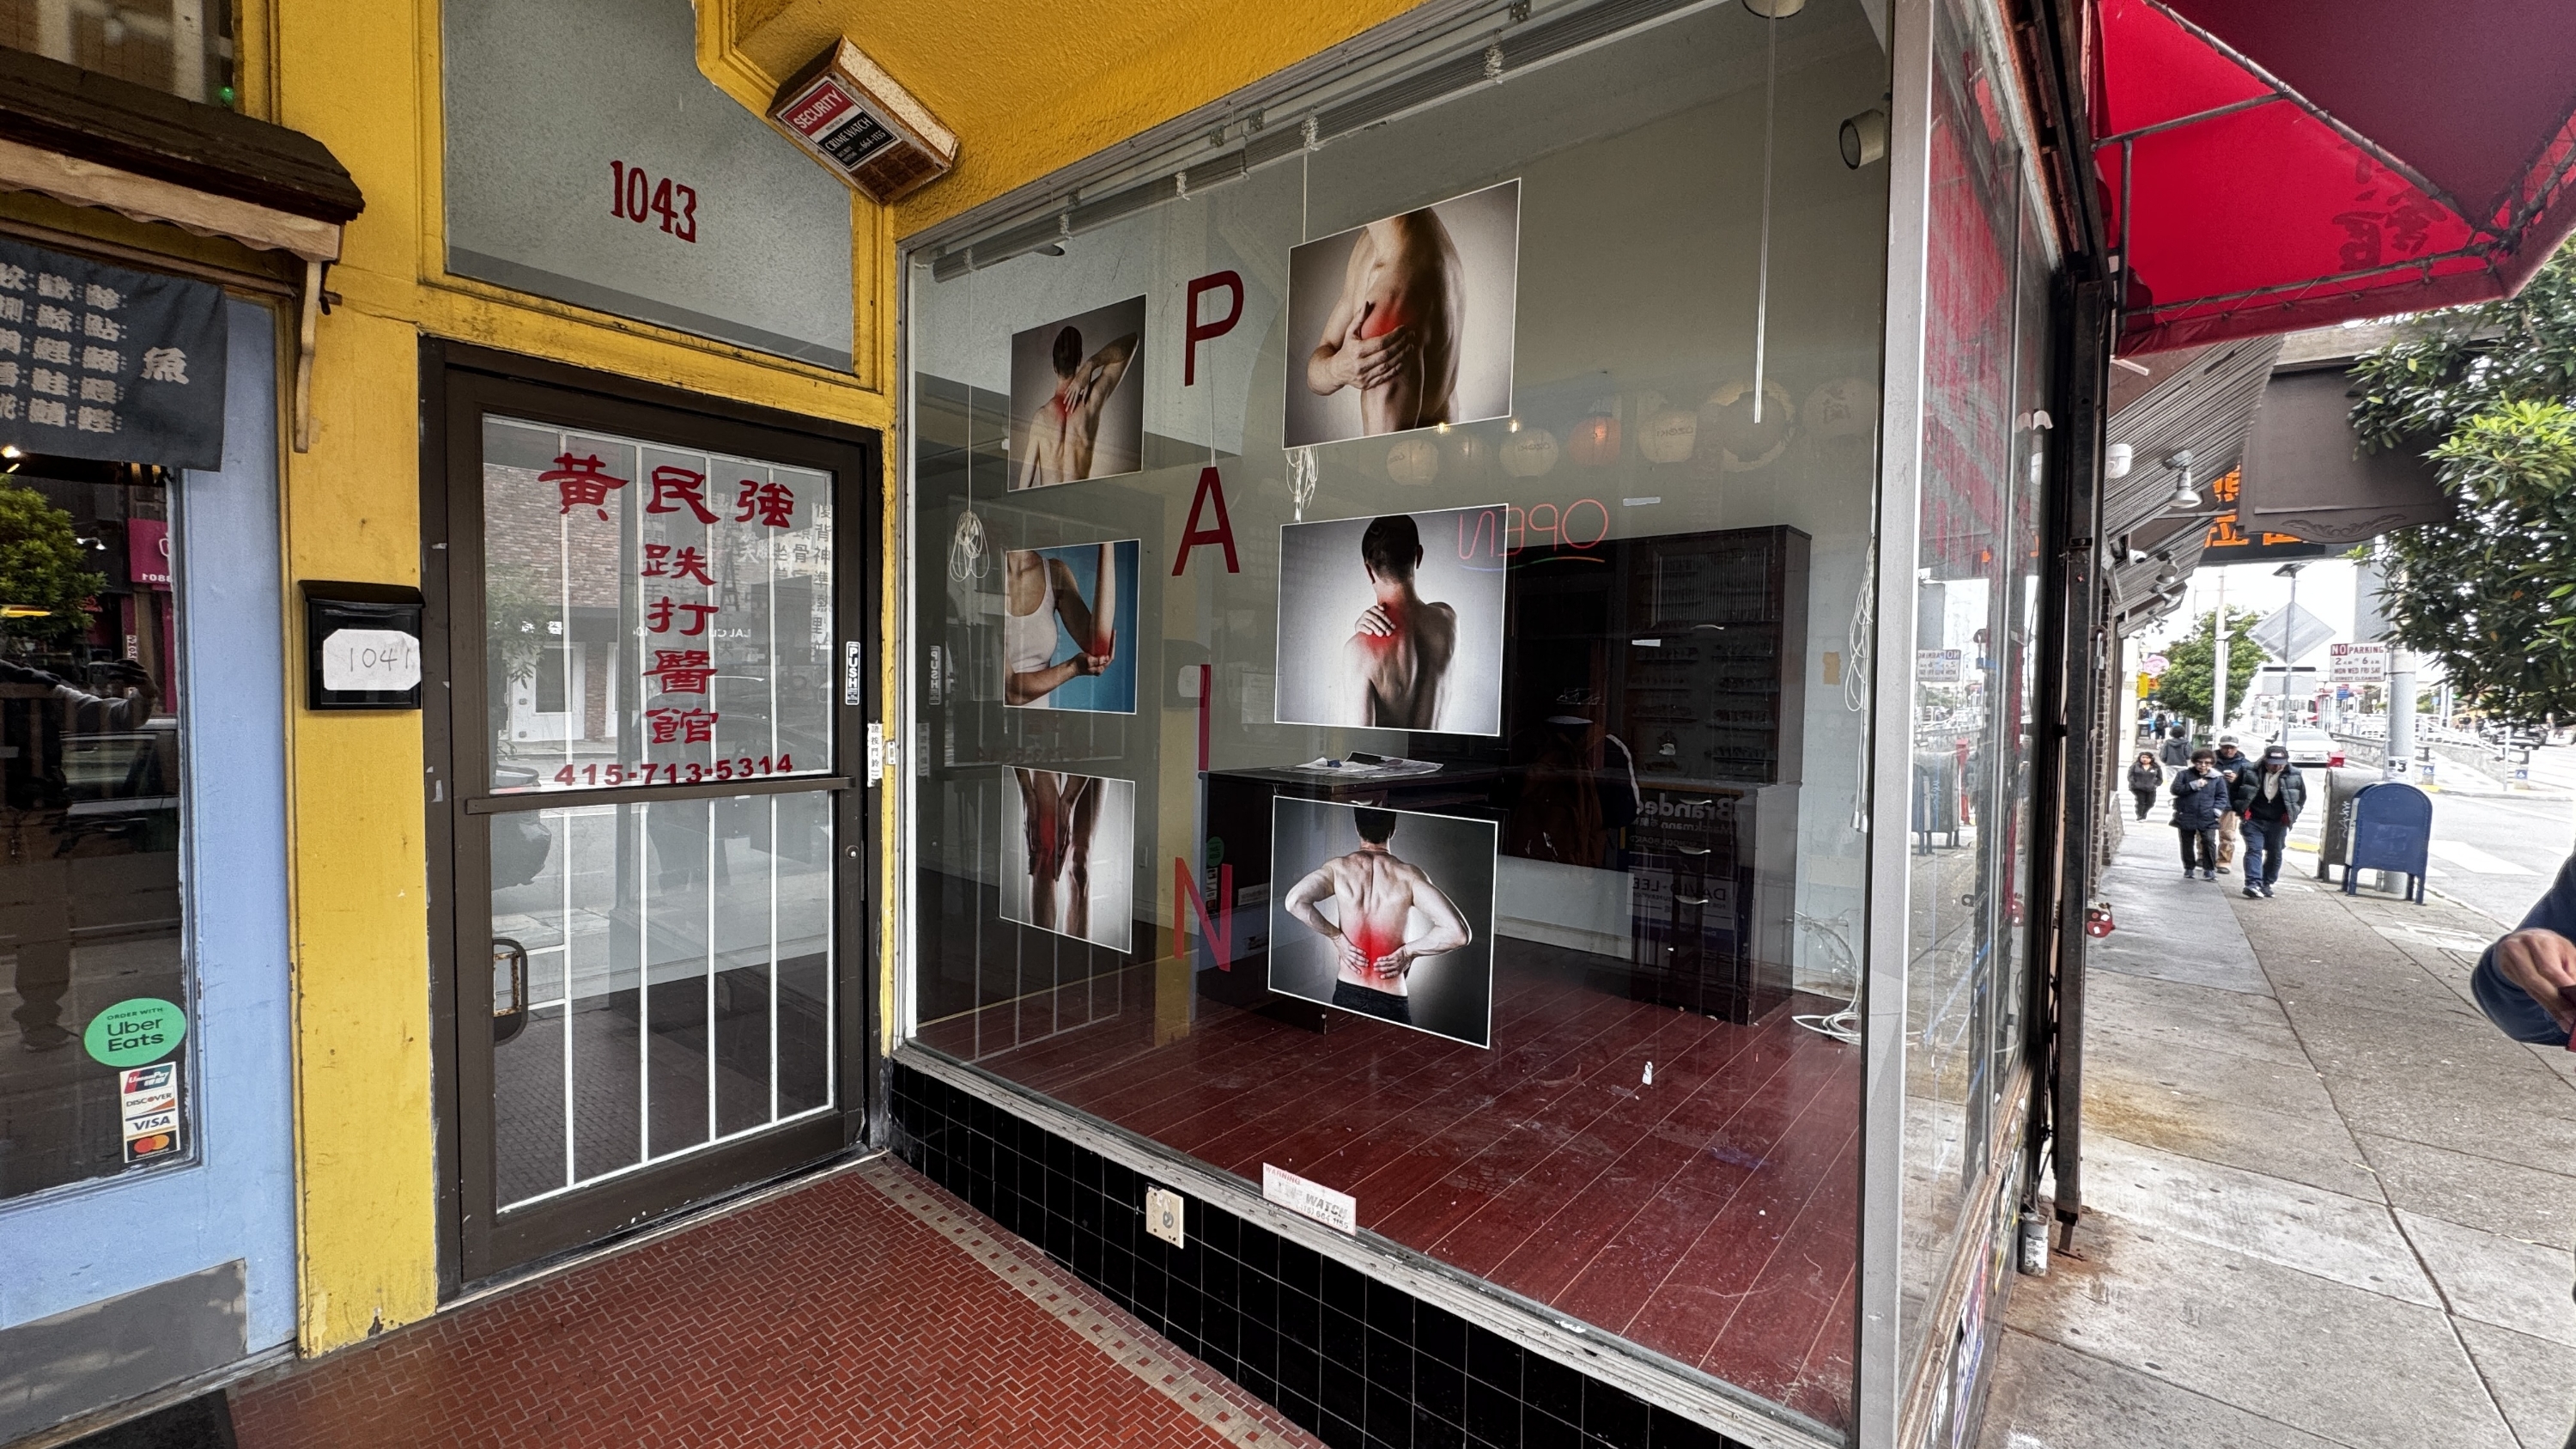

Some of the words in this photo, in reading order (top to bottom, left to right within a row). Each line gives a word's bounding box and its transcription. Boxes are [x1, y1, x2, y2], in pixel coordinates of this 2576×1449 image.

[793, 89, 843, 129] SECURITY
[825, 131, 849, 151] CRIME
[846, 116, 873, 139] WATCH
[611, 160, 696, 244] 1043
[140, 347, 190, 385] 魚
[641, 544, 720, 745] 跌打醫館
[2331, 644, 2347, 655] NO
[2348, 645, 2384, 654] PARKING
[349, 647, 410, 673] 1041
[848, 647, 859, 689] PUSH
[2335, 657, 2342, 666] 2
[2362, 656, 2368, 665] 6
[554, 753, 793, 786] 415-713-5314
[2397, 762, 2407, 773] 3
[106, 1011, 137, 1020] ORDER
[107, 1019, 163, 1036] Uber
[108, 1033, 164, 1052] Eats
[126, 1092, 173, 1107] DISCOVER
[133, 1115, 171, 1131] VISA
[1265, 1166, 1301, 1185] WARNING
[1305, 1193, 1349, 1219] WATCH
